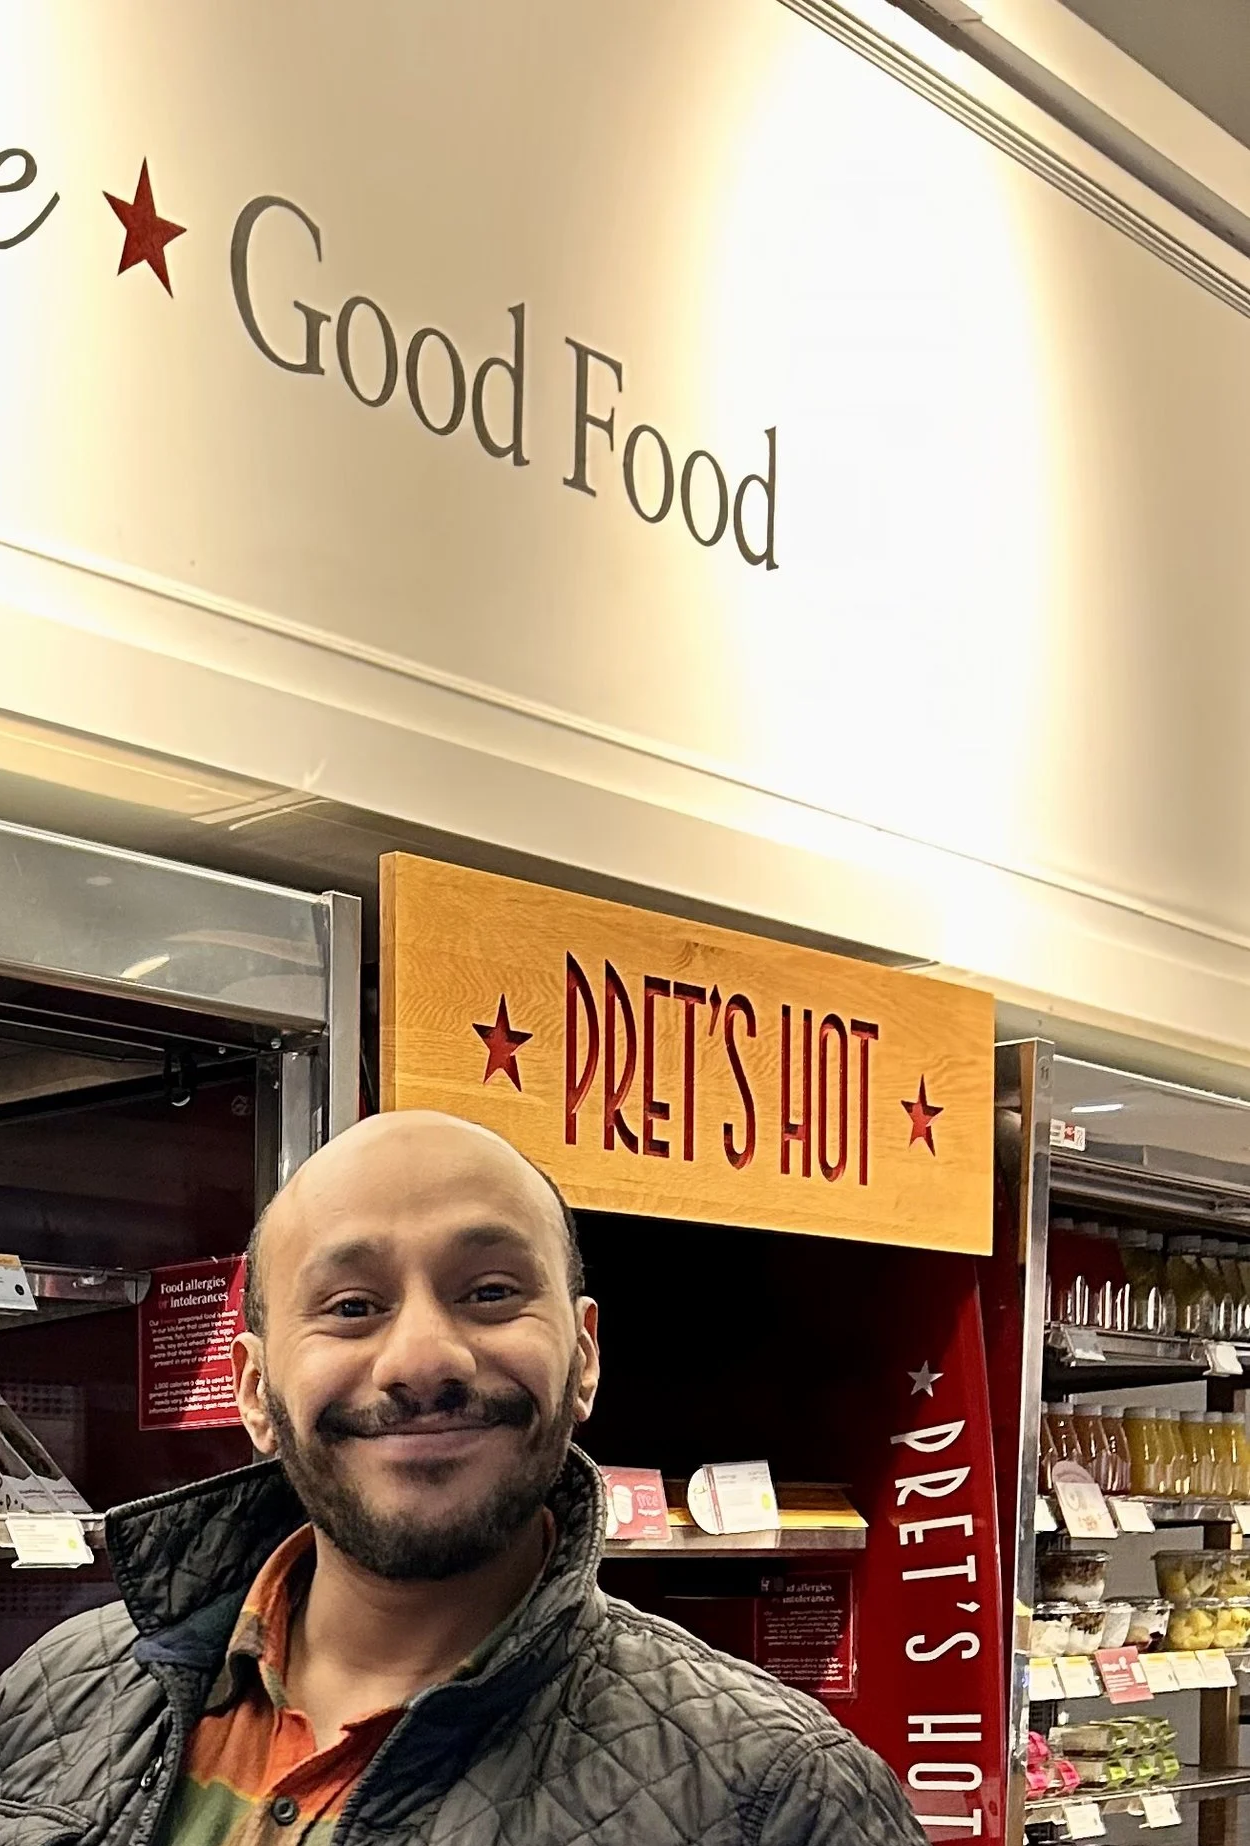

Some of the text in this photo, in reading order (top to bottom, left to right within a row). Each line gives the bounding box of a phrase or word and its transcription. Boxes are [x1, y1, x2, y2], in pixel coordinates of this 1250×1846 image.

[230, 195, 530, 467] Good
[562, 336, 779, 571] Food
[564, 950, 879, 1186] PRET'S HOT
[160, 1276, 226, 1295] Food allergies
[170, 1292, 229, 1308] intolerances
[890, 1420, 983, 1836] PRET'S HOT
